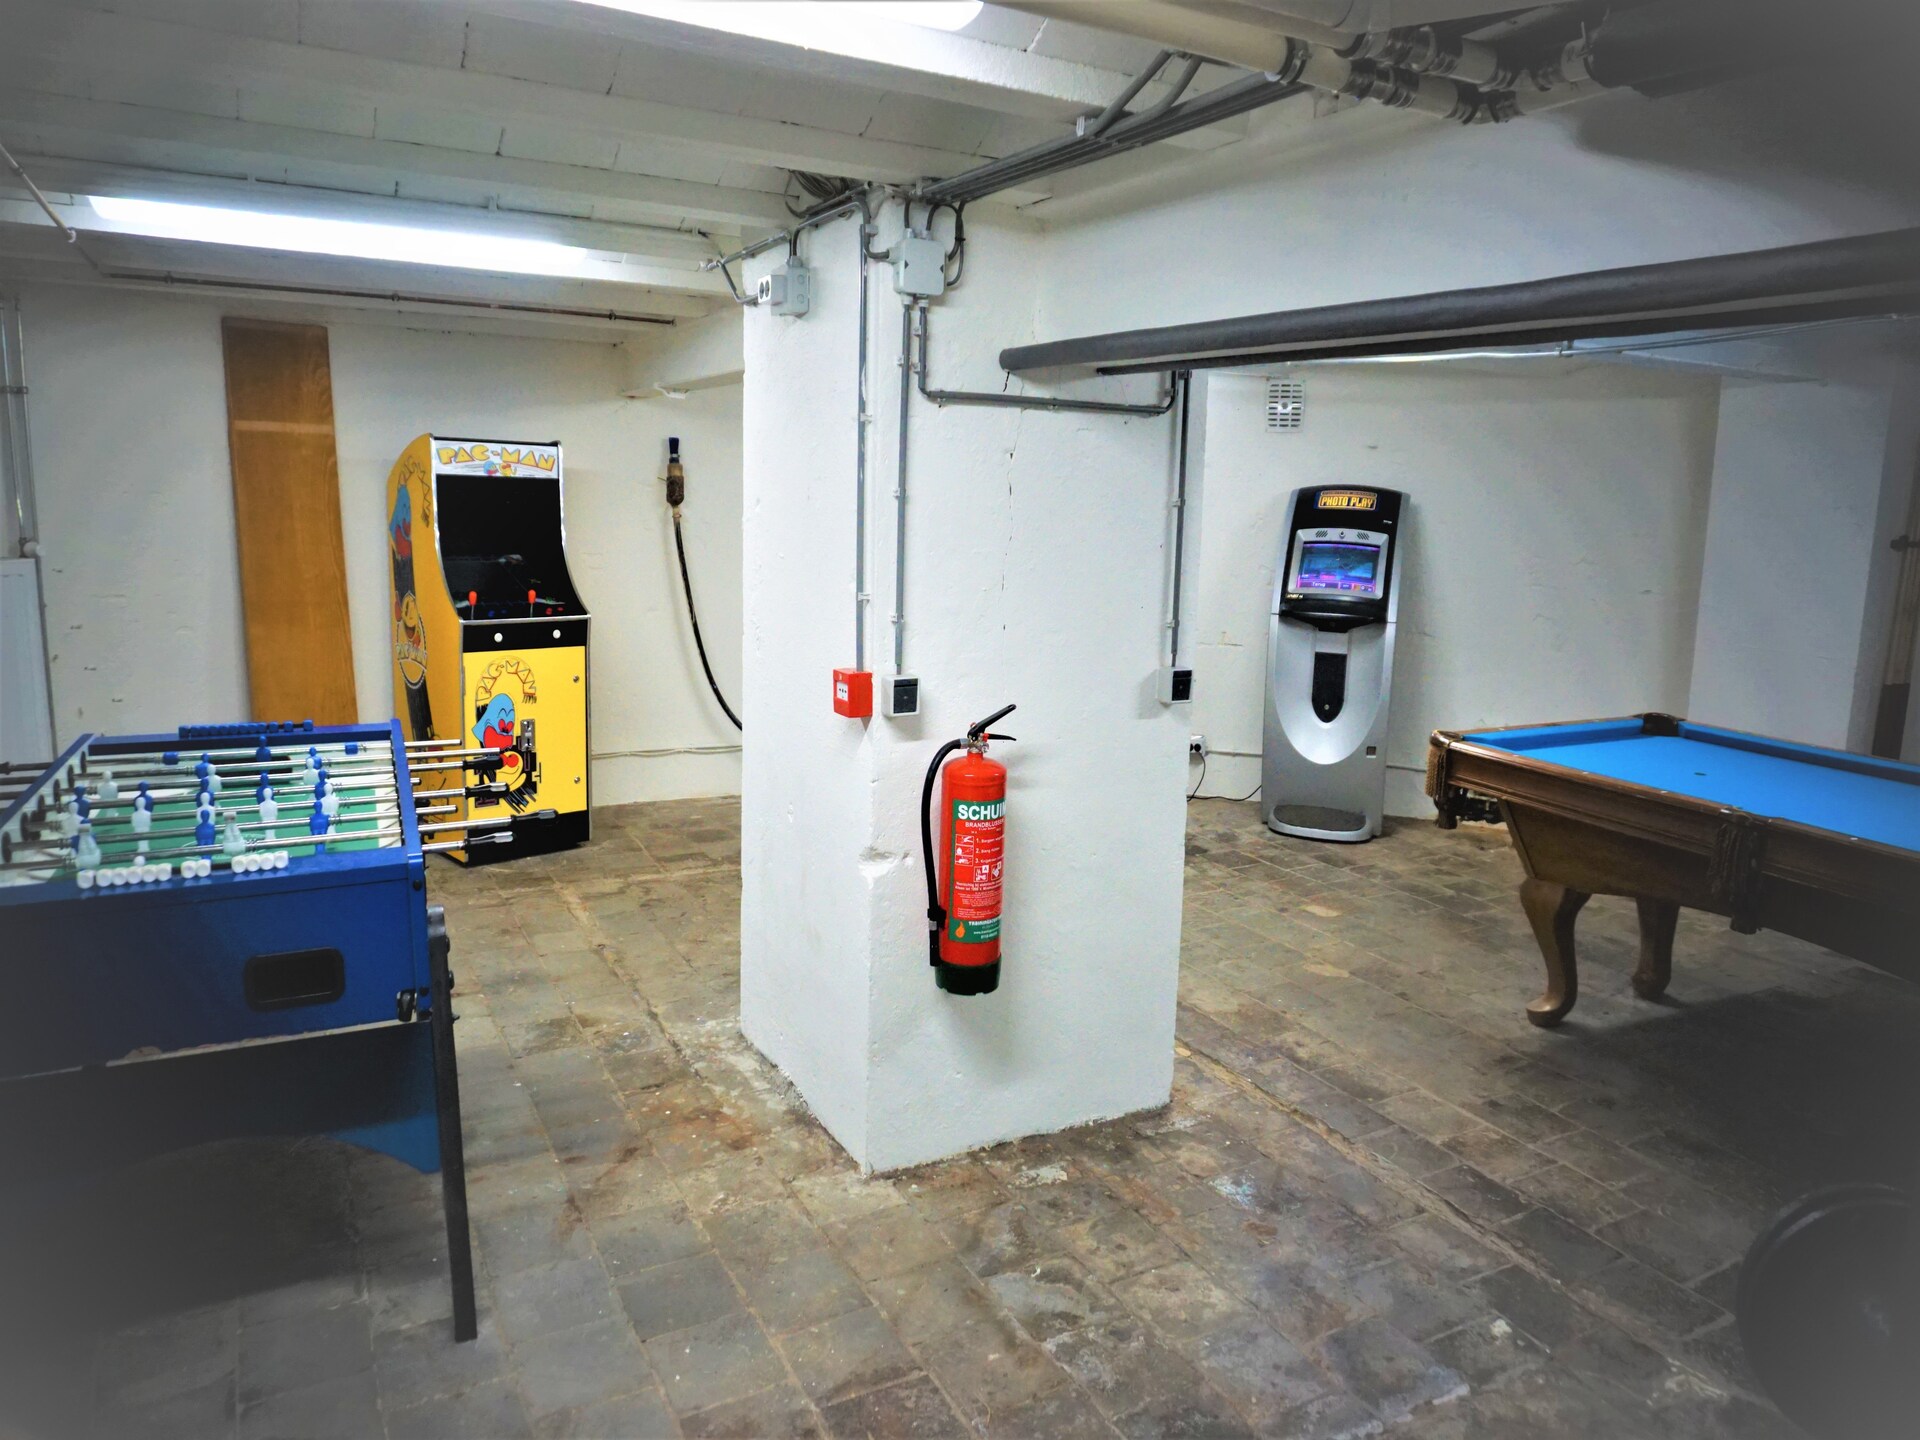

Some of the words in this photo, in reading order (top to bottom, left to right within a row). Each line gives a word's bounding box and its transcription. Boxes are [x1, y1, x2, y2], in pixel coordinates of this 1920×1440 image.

[436, 444, 556, 472] PAC-MAN
[1321, 496, 1349, 506] PHOTO
[1350, 497, 1373, 508] PLAY
